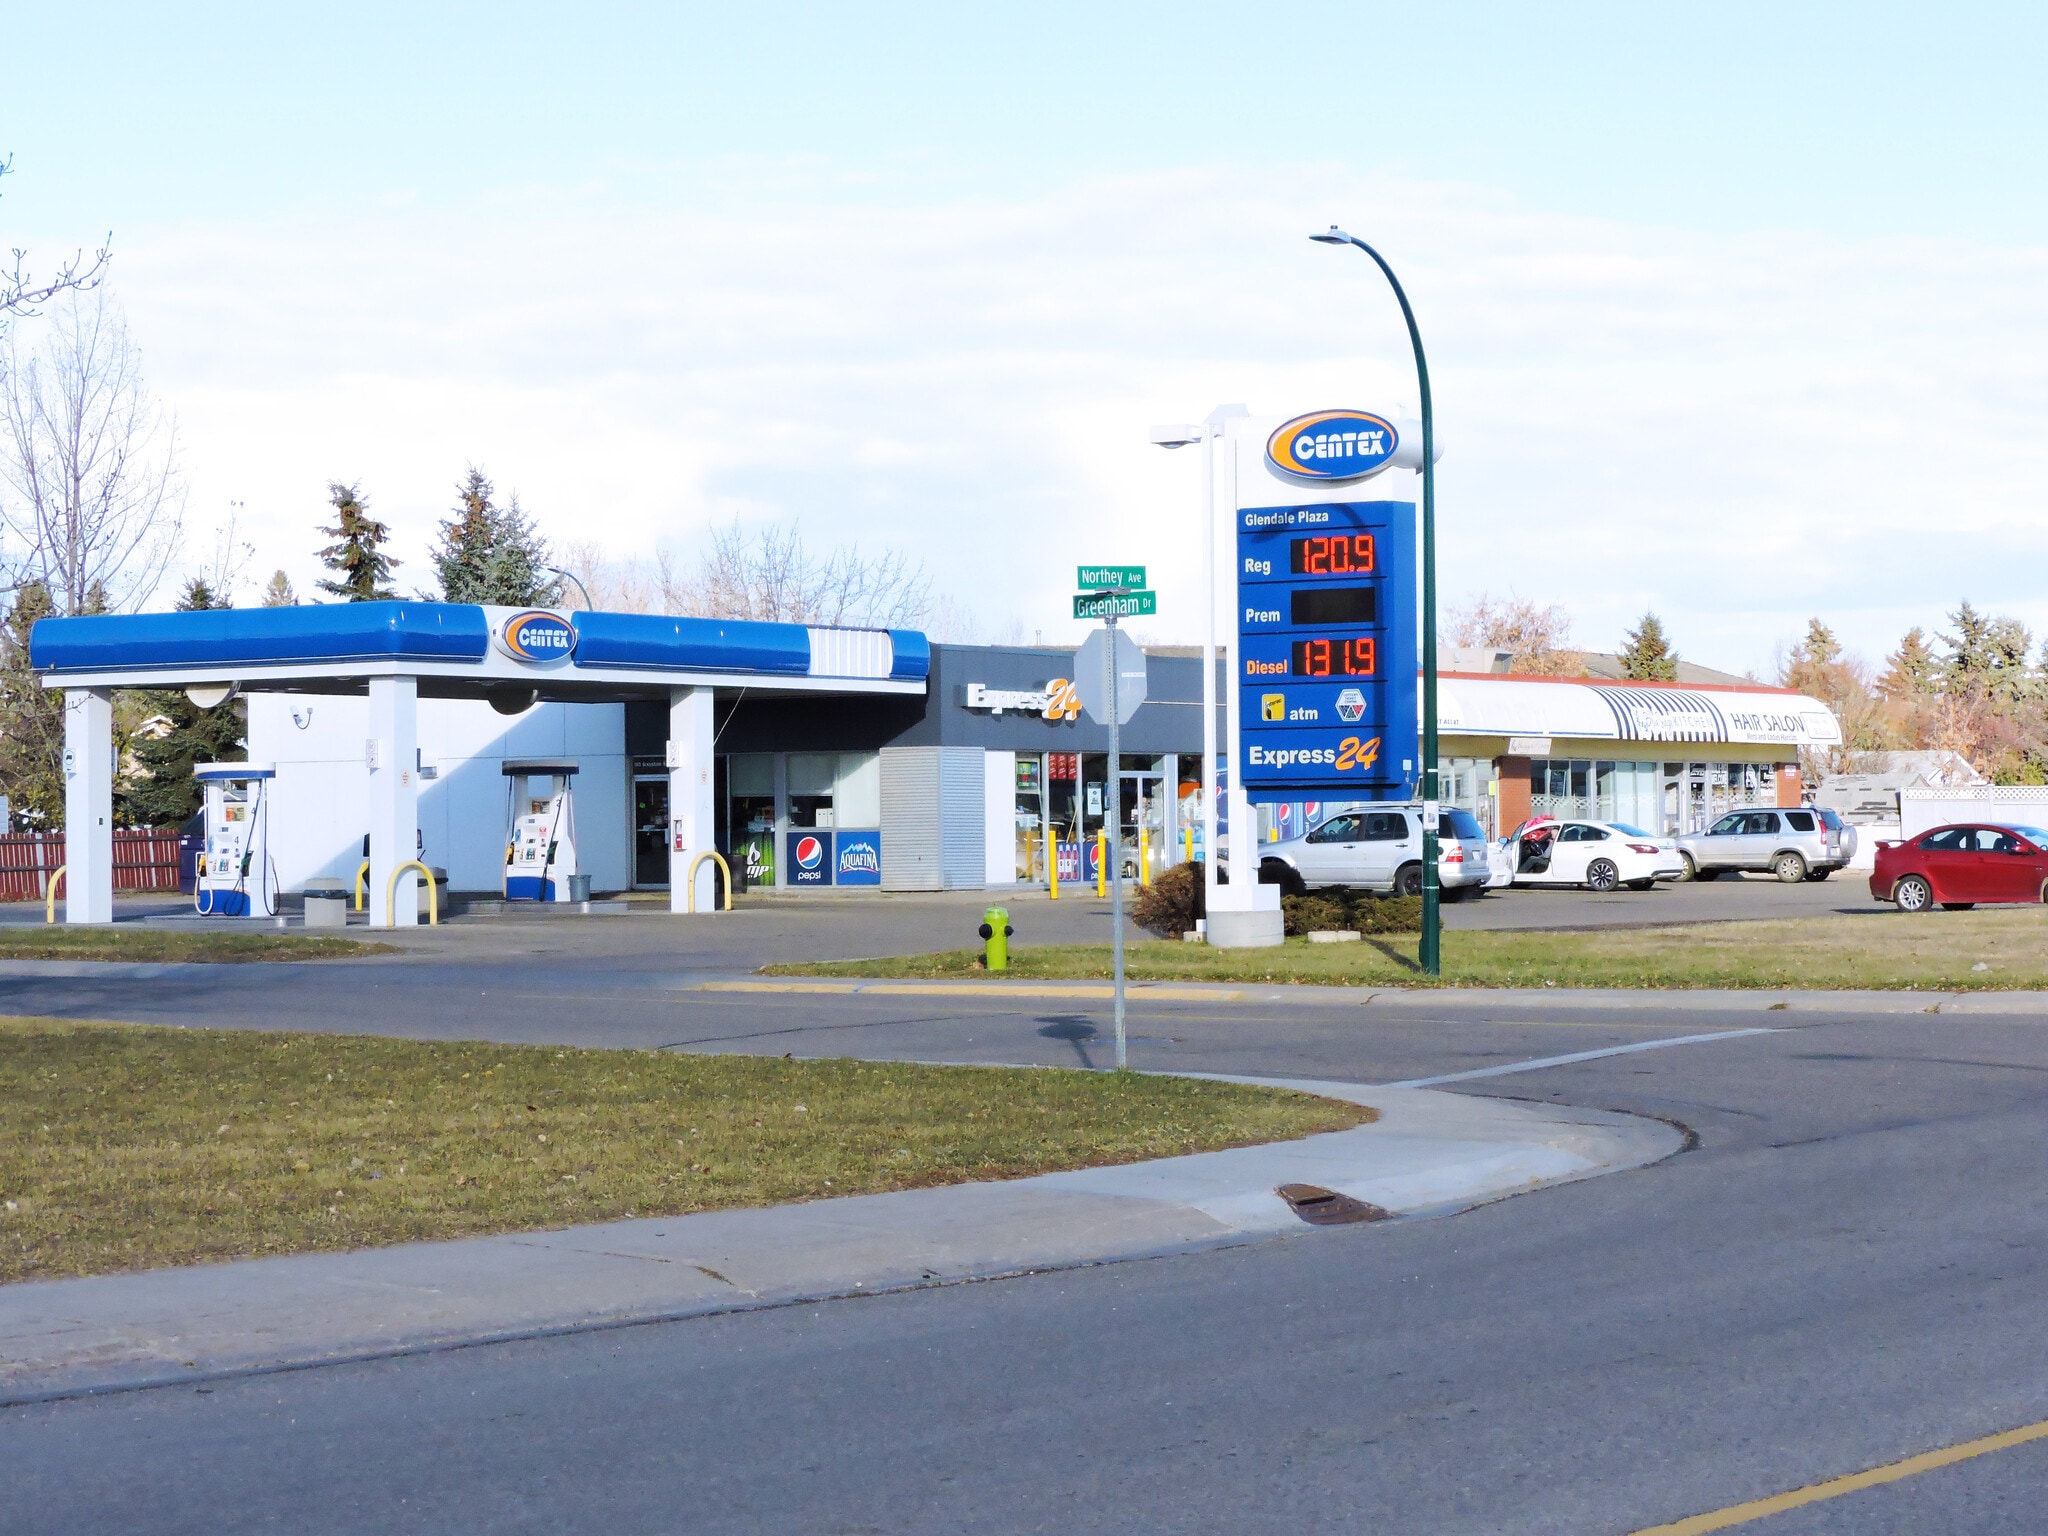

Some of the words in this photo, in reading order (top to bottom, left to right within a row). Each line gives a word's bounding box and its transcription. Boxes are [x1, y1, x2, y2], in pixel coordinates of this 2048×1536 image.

[1295, 430, 1385, 460] CENTEX
[1245, 512, 1295, 526] Glendale
[1298, 511, 1329, 524] Plaza
[1245, 558, 1271, 575] Reg
[1303, 534, 1374, 574] 120.9
[1081, 568, 1123, 587] Northey
[1128, 572, 1142, 583] Ave
[1077, 595, 1139, 616] Greenham
[1143, 598, 1152, 608] Dr
[1245, 608, 1281, 623] Prem
[520, 628, 569, 648] CENTEX
[1246, 659, 1288, 675] Diesel
[1305, 638, 1376, 677] 131.9
[1289, 706, 1319, 720] atm
[1730, 712, 1762, 731] HAIR
[1763, 714, 1805, 732] SALON
[839, 852, 879, 872] AQUAFINA
[797, 870, 821, 881] pepsi
